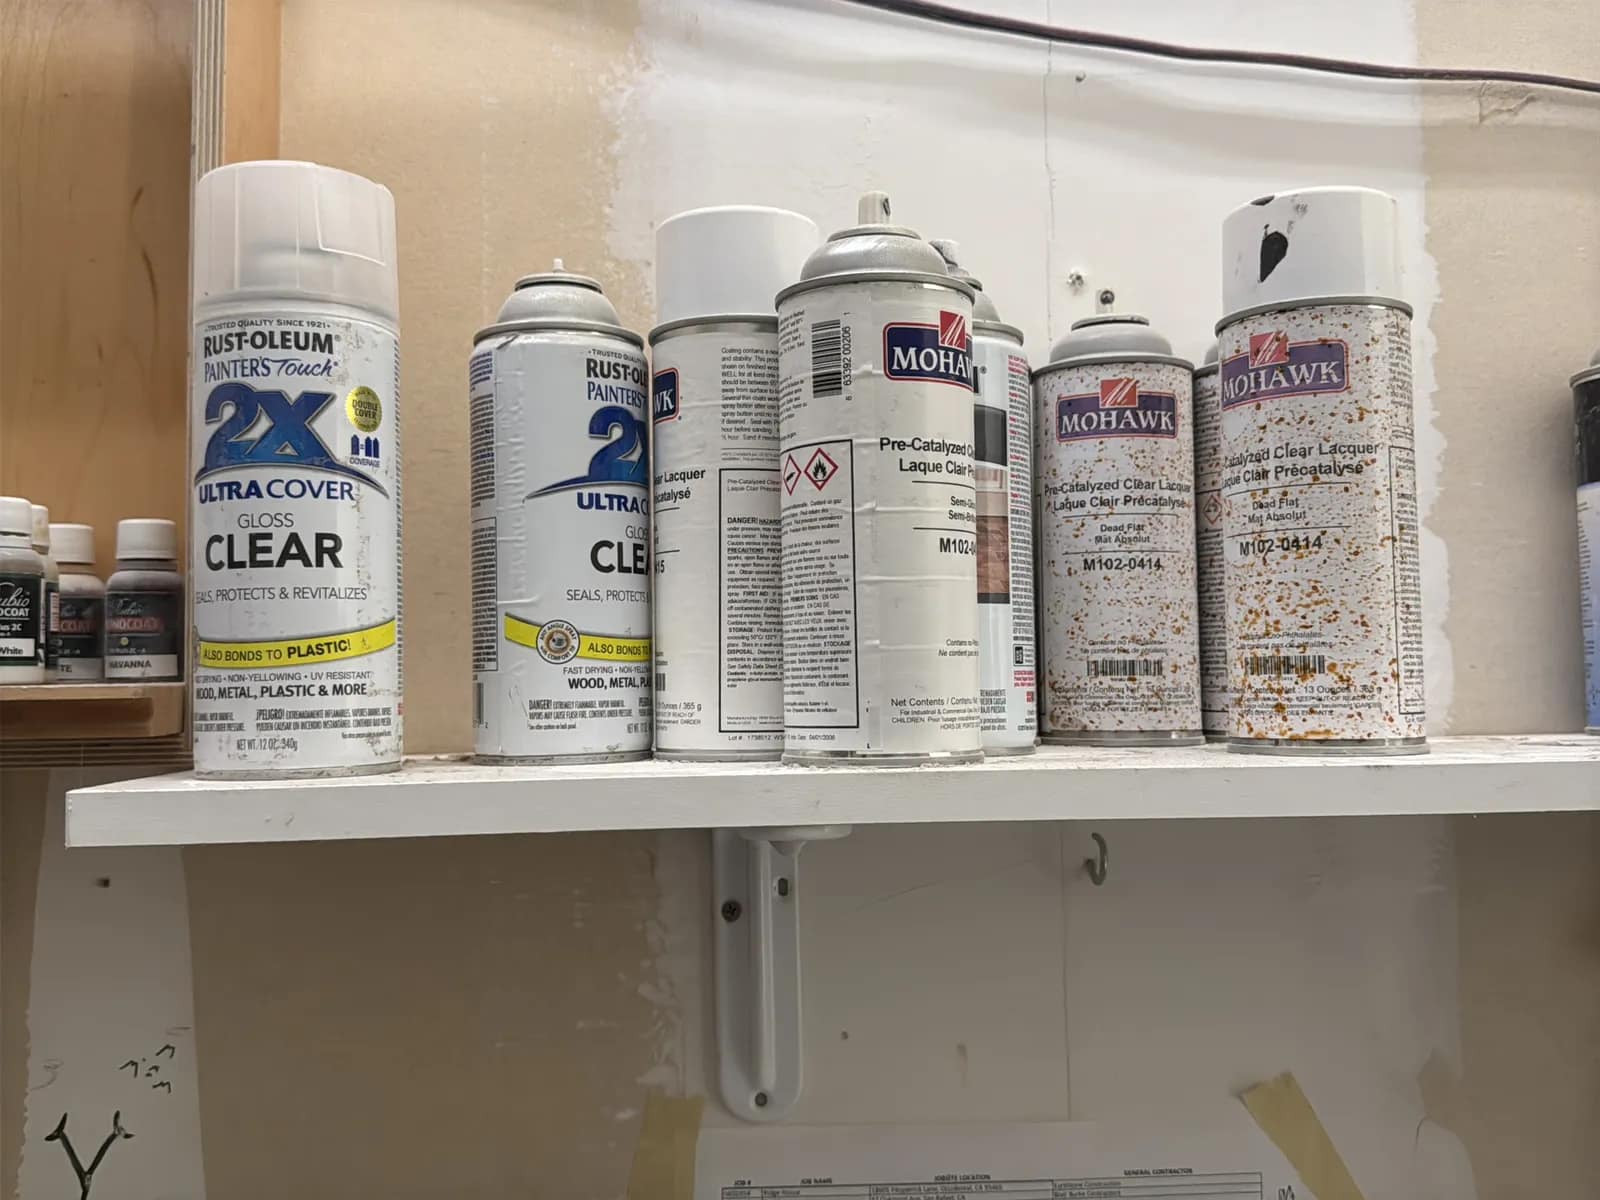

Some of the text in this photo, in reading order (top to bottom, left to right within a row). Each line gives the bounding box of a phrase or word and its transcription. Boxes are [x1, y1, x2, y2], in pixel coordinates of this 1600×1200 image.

[237, 318, 274, 327] QUALITY
[276, 318, 305, 327] SINCE
[841, 325, 851, 356] 00206
[204, 356, 333, 383] PAINTER'S Touch
[842, 357, 852, 386] 63392
[1223, 360, 1342, 402] MOHAWK
[352, 399, 377, 411] DOUBLE
[354, 408, 377, 420] COVER
[205, 382, 337, 466] 2X
[1060, 409, 1175, 435] MOHAWK
[879, 437, 967, 457] Pre-Catalyzed
[1273, 444, 1312, 459] Clear
[1318, 443, 1379, 456] Lacquer
[899, 458, 967, 476] Laque Clair
[664, 469, 706, 483] Lacquer
[1243, 468, 1270, 483] Clair
[1044, 478, 1192, 497] Pre-Catalyzed Clear Lacquer
[1053, 497, 1086, 511] Laque
[1089, 496, 1120, 508] Clair
[1252, 498, 1299, 510] Dead Flat
[237, 512, 294, 529] GLOSS
[727, 516, 759, 524] DANGER!
[1248, 511, 1307, 523] Mat Absolut
[1100, 523, 1145, 533] Dead Flat
[1095, 534, 1150, 545] Mat Absolut
[1240, 535, 1323, 556] M102-0414
[205, 531, 344, 572] CLEAR
[1083, 558, 1162, 571] M102-0414
[216, 586, 368, 601] PROTECTS & REVITALIZES
[566, 589, 604, 603] SEALS,
[204, 639, 352, 661] ALSO BONDS TO PLASTIC!
[588, 642, 641, 656] ALSO BONDS
[938, 649, 948, 657] Ne
[228, 671, 371, 683] NON-YELLOWING UV RESISTANT
[563, 666, 613, 675] FAST DRYING
[568, 677, 639, 690] WOOD, METAL,
[218, 683, 368, 700] METAL, PLASTIC & MORE
[529, 699, 552, 710] DANGER!
[697, 703, 702, 712] g
[890, 697, 945, 707] Net Contents
[566, 711, 578, 719] FLASH
[260, 738, 267, 750] 12
[959, 1173, 991, 1181] LOCATION
